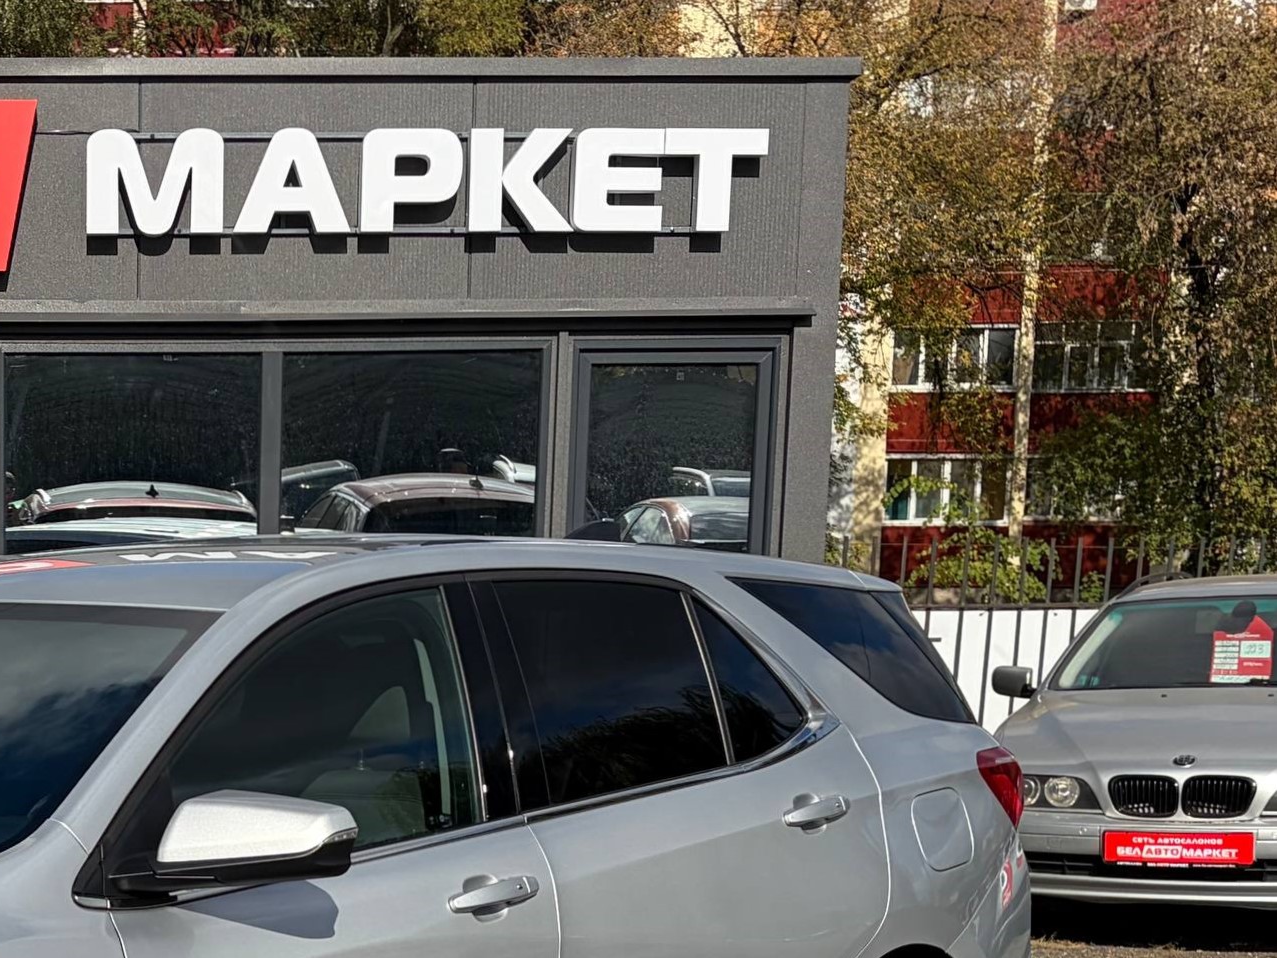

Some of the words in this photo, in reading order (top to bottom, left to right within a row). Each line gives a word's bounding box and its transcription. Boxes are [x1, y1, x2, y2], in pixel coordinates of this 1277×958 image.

[86, 127, 769, 236] МАРКЕТ
[1132, 836, 1155, 844] СЕТЬ
[1157, 837, 1224, 845] АВТОСАЛОНОВ
[1116, 846, 1142, 857] БЕЛ
[1146, 846, 1179, 857] АВТО
[1182, 848, 1239, 858] МАРКЕТ
